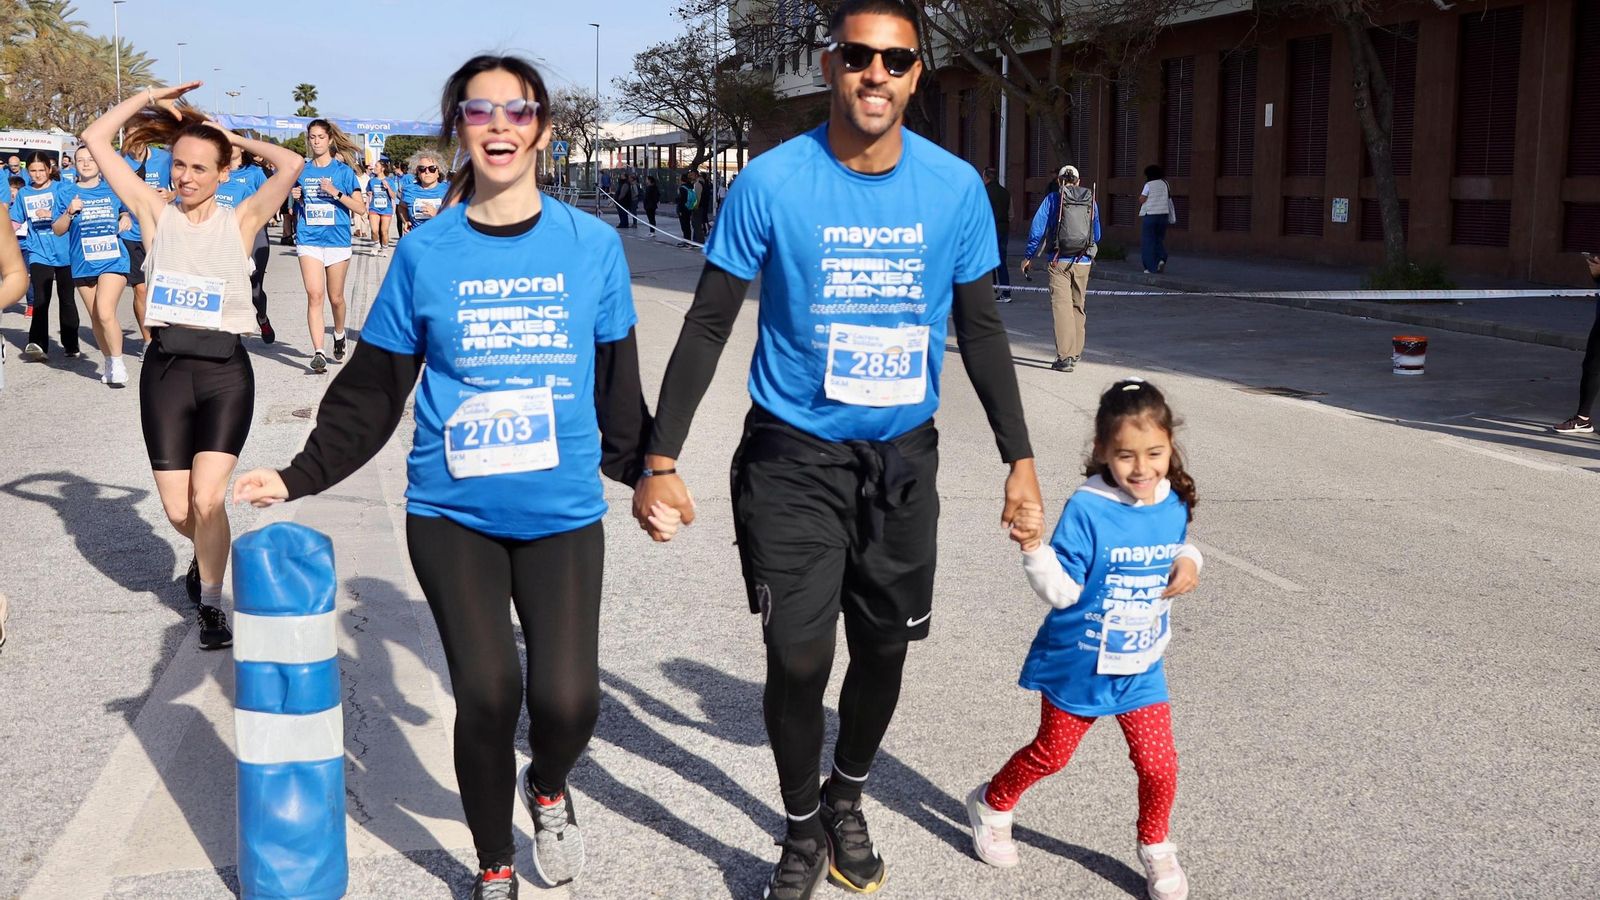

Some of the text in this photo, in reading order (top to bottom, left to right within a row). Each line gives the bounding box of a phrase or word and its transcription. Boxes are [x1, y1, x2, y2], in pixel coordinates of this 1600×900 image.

[357, 121, 390, 131] mayoral
[312, 209, 328, 218] 1347
[823, 222, 923, 248] mayoral
[821, 257, 922, 271] RUNNING
[459, 272, 564, 298] mayoral
[831, 271, 914, 285] MAKES
[165, 288, 209, 308] 1595
[457, 305, 564, 323] RUNNING
[468, 320, 556, 336] MAKES
[849, 351, 911, 377] 2858
[463, 416, 532, 446] 2703
